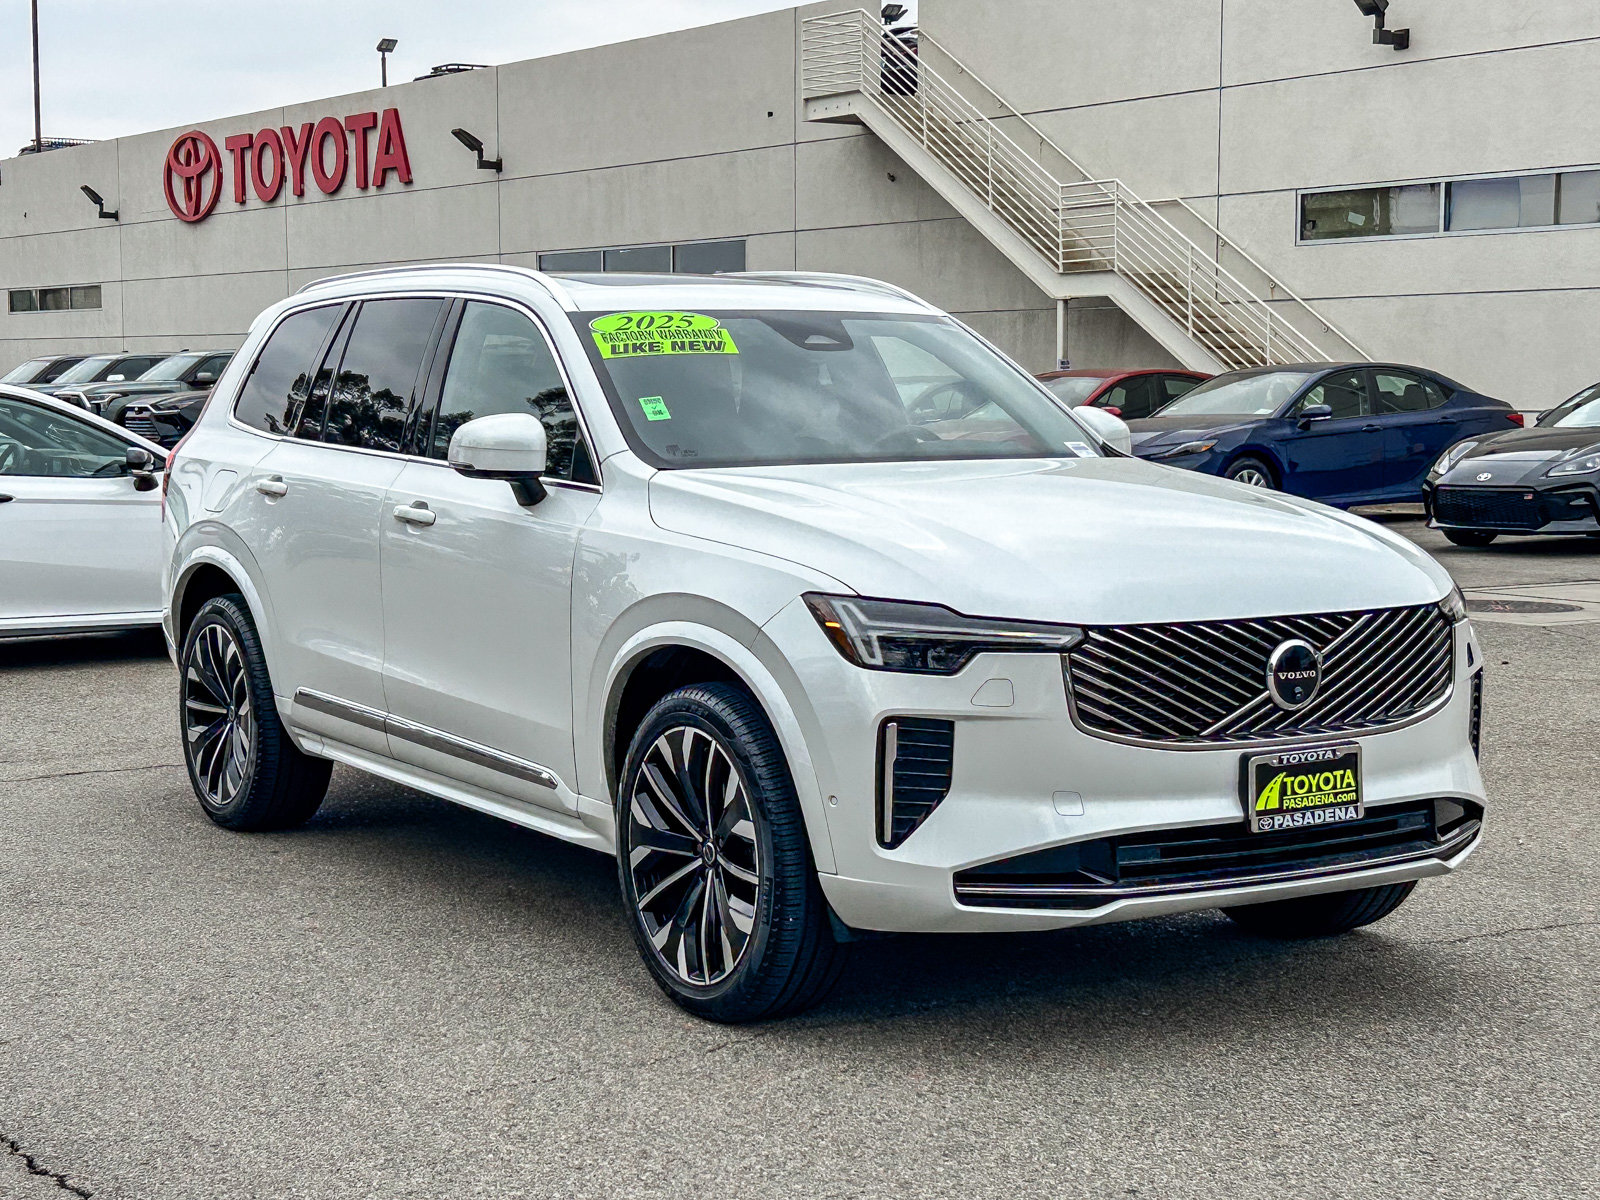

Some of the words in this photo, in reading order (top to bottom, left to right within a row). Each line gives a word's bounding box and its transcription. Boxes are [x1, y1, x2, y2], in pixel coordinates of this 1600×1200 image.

[225, 107, 413, 204] TOYOTA
[613, 314, 695, 332] 2025
[600, 329, 654, 344] FACTORY
[656, 328, 724, 341] WARRANTY
[610, 341, 664, 355] LIKE
[671, 340, 727, 353] NEW
[1277, 670, 1316, 680] VOLVO
[1281, 750, 1334, 764] TOYOTA
[1283, 769, 1356, 796] TOYOTA
[1283, 791, 1357, 810] PASADENA.com
[1274, 806, 1357, 829] PASADENA
